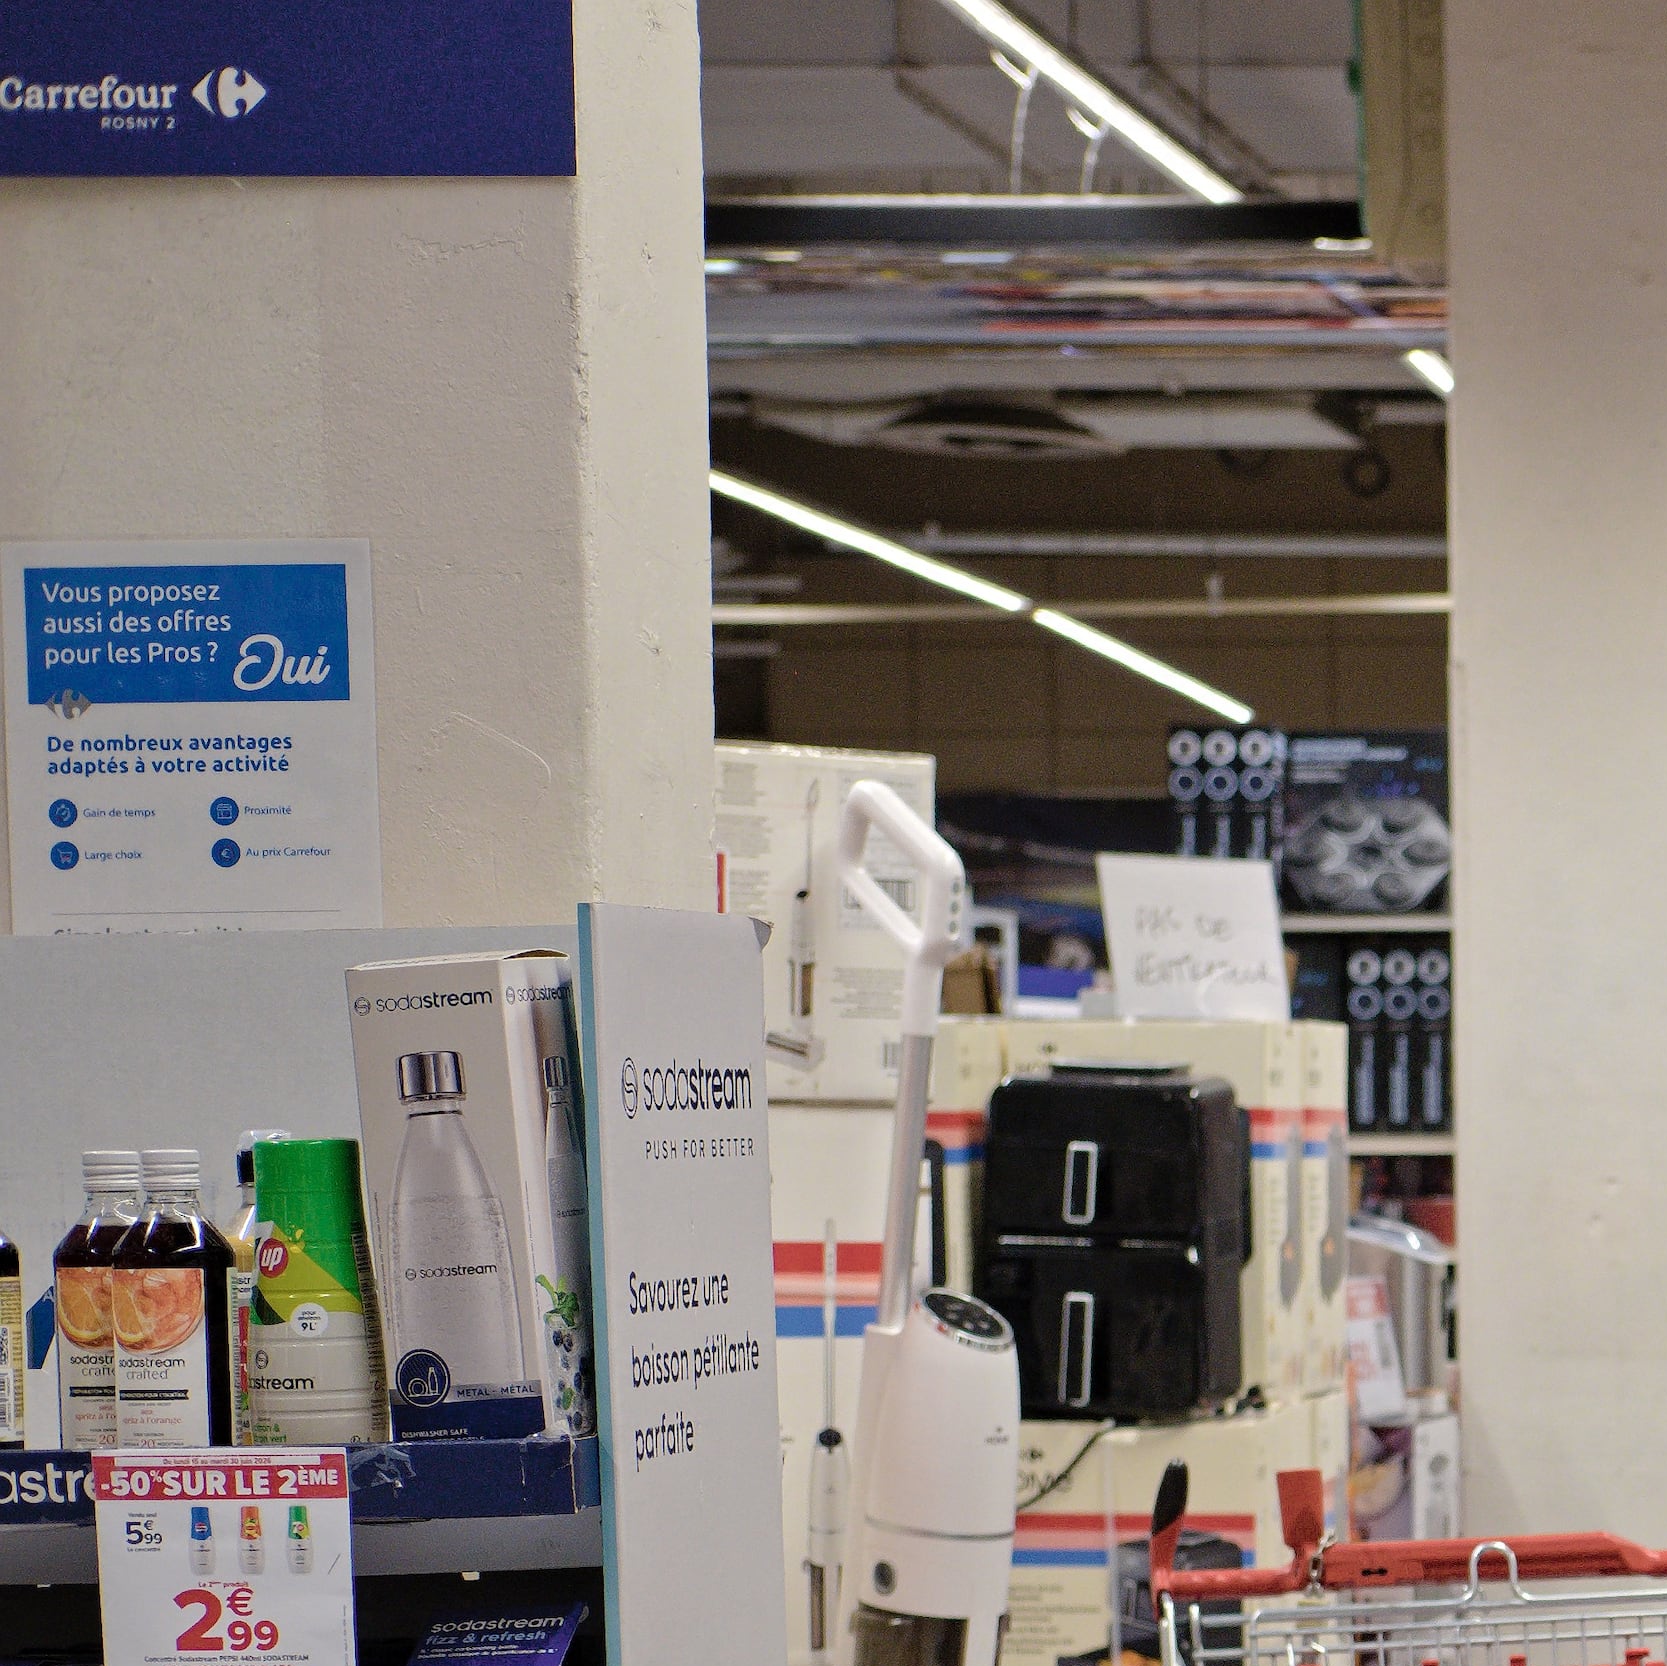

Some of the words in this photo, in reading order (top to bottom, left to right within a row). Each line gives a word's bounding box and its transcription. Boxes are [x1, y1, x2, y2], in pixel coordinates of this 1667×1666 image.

[0, 75, 176, 111] Carrefour
[101, 116, 160, 131] ROSNY
[166, 116, 177, 130] 2
[42, 583, 102, 604] Vous
[109, 583, 220, 606] proposez
[43, 612, 102, 634] aussi
[109, 612, 151, 633] des
[158, 609, 232, 632] offres
[45, 645, 102, 669] pour
[107, 642, 141, 664] les
[149, 642, 201, 663] Pros
[232, 633, 331, 691] Oui
[47, 736, 74, 753] De
[80, 734, 183, 752] nombreux
[189, 733, 293, 755] avantages
[47, 757, 129, 777] adaptés
[135, 756, 146, 774] à
[152, 757, 207, 773] votre
[212, 754, 290, 773] activité
[82, 806, 106, 818] Gain
[244, 803, 292, 816] Proximité
[84, 848, 113, 862] Large
[115, 848, 142, 860] choix
[375, 987, 493, 1013] sodastream
[643, 1058, 752, 1111] sodastream
[645, 1139, 679, 1161] PUSH
[684, 1138, 706, 1159] FOR
[712, 1137, 754, 1158] BETTER
[419, 1261, 498, 1280] sodastream
[629, 1271, 699, 1315] Savourez
[703, 1272, 729, 1304] une
[118, 1356, 186, 1369] sodastream
[632, 1343, 689, 1388] boisson
[694, 1330, 760, 1389] pétillante
[635, 1411, 694, 1472] parfaite
[162, 1469, 226, 1497] SUR
[235, 1469, 269, 1496] LE
[431, 1615, 565, 1634] sodastream
[425, 1633, 460, 1646] fizz
[481, 1630, 545, 1644] refresh
